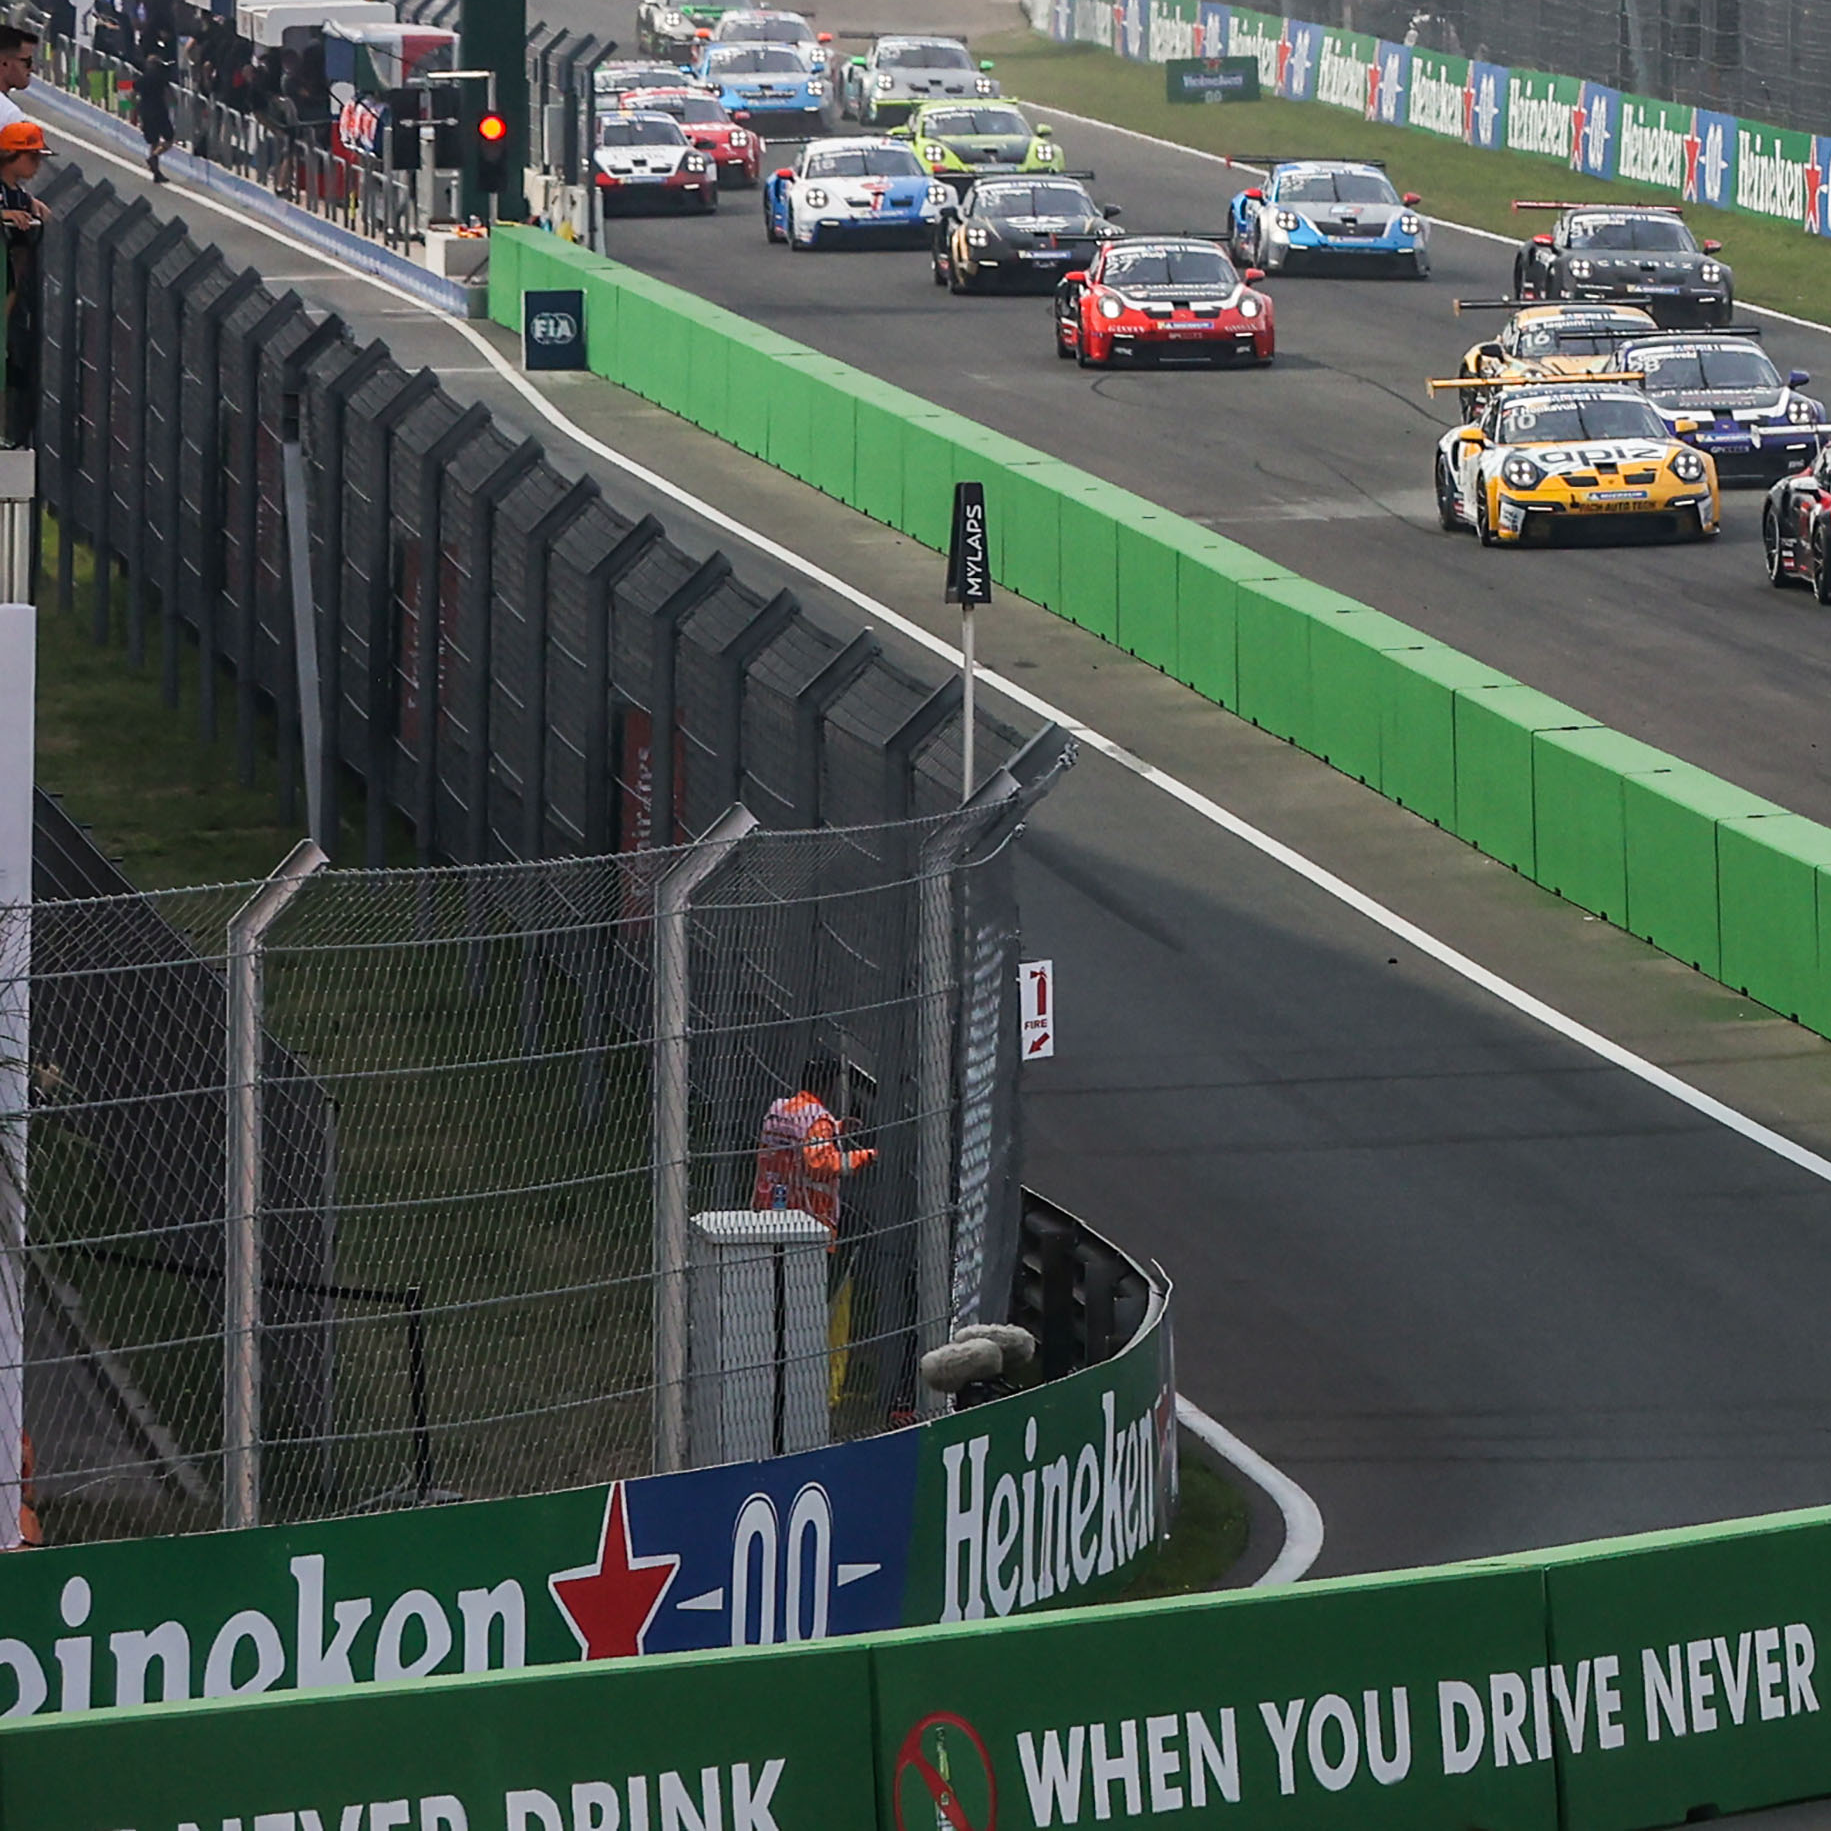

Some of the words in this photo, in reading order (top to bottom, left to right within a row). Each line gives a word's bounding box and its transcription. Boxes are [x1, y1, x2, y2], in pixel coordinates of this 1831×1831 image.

[1619, 103, 1683, 189] Heineken
[1736, 129, 1804, 221] Heineken
[533, 318, 574, 339] FIA
[1521, 332, 1550, 349] 16
[1503, 413, 1537, 432] 10
[1538, 445, 1664, 467] apiz
[966, 504, 983, 596] MYLAPS
[1024, 1018, 1048, 1030] FIRE
[941, 1390, 1155, 1624] Heineken
[1016, 1706, 1241, 1828] WHEN
[1259, 1687, 1409, 1790] YOU
[1437, 1654, 1627, 1776] DRIVE
[1642, 1624, 1822, 1741] NEVER
